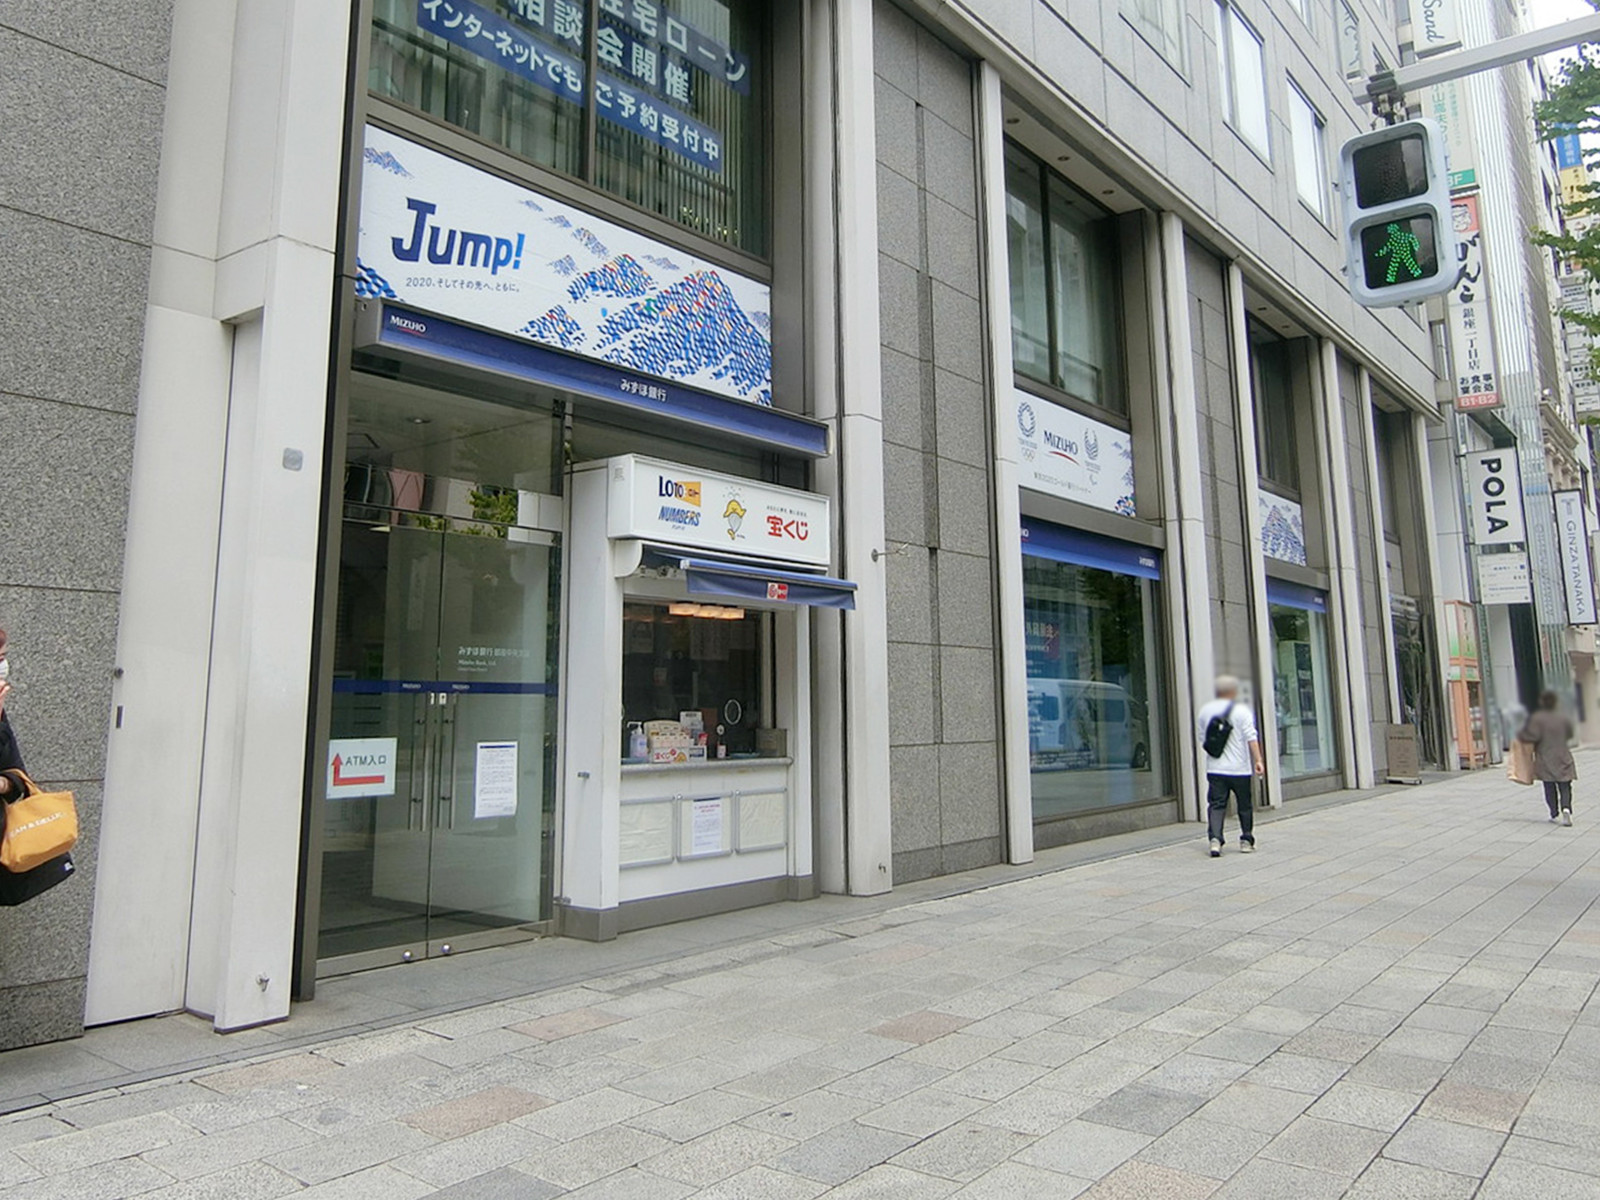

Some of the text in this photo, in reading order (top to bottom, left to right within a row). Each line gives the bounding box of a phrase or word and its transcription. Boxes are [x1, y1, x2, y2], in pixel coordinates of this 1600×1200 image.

[391, 197, 525, 275] Jump!
[390, 315, 427, 333] MIZUHO
[620, 378, 667, 402] みずほ銀行
[1044, 430, 1079, 456] MIZUHO
[659, 475, 684, 498] LOTO
[1480, 457, 1509, 534] POLA
[658, 505, 701, 527] NUMBERS
[767, 515, 809, 541] 宝くじ
[345, 755, 387, 766] ATM入口
